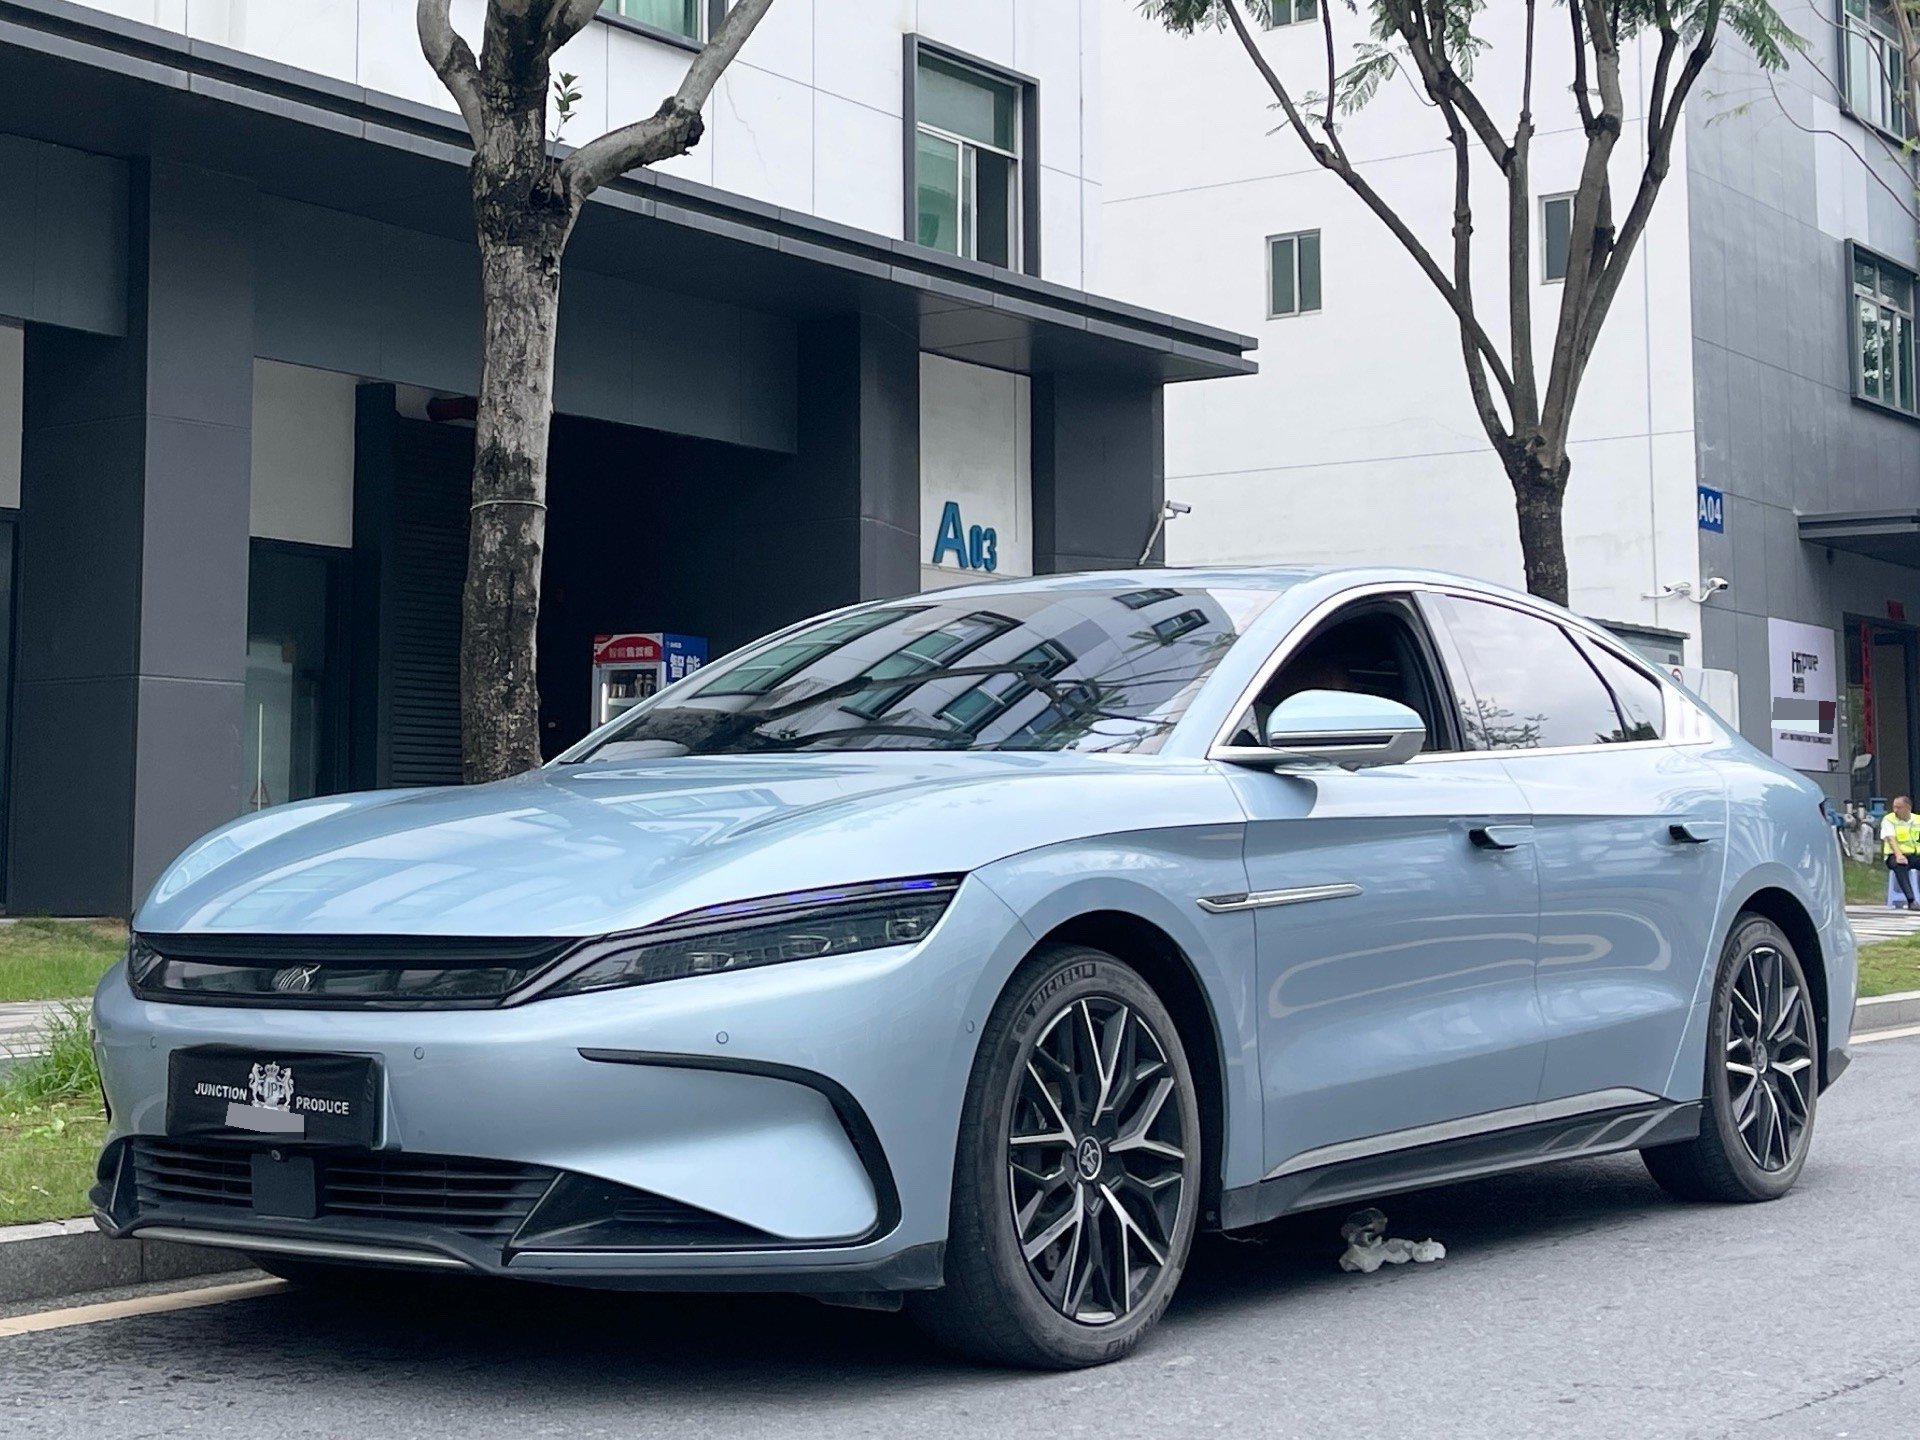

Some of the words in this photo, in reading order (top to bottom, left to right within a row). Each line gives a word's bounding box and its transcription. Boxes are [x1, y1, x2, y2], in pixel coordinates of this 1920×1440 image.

[1699, 493, 1722, 525] A04
[932, 501, 997, 572] A03
[1031, 963, 1097, 1014] MICHELIN
[194, 1082, 248, 1101] JUNCTION
[296, 1096, 350, 1115] PRODUCE
